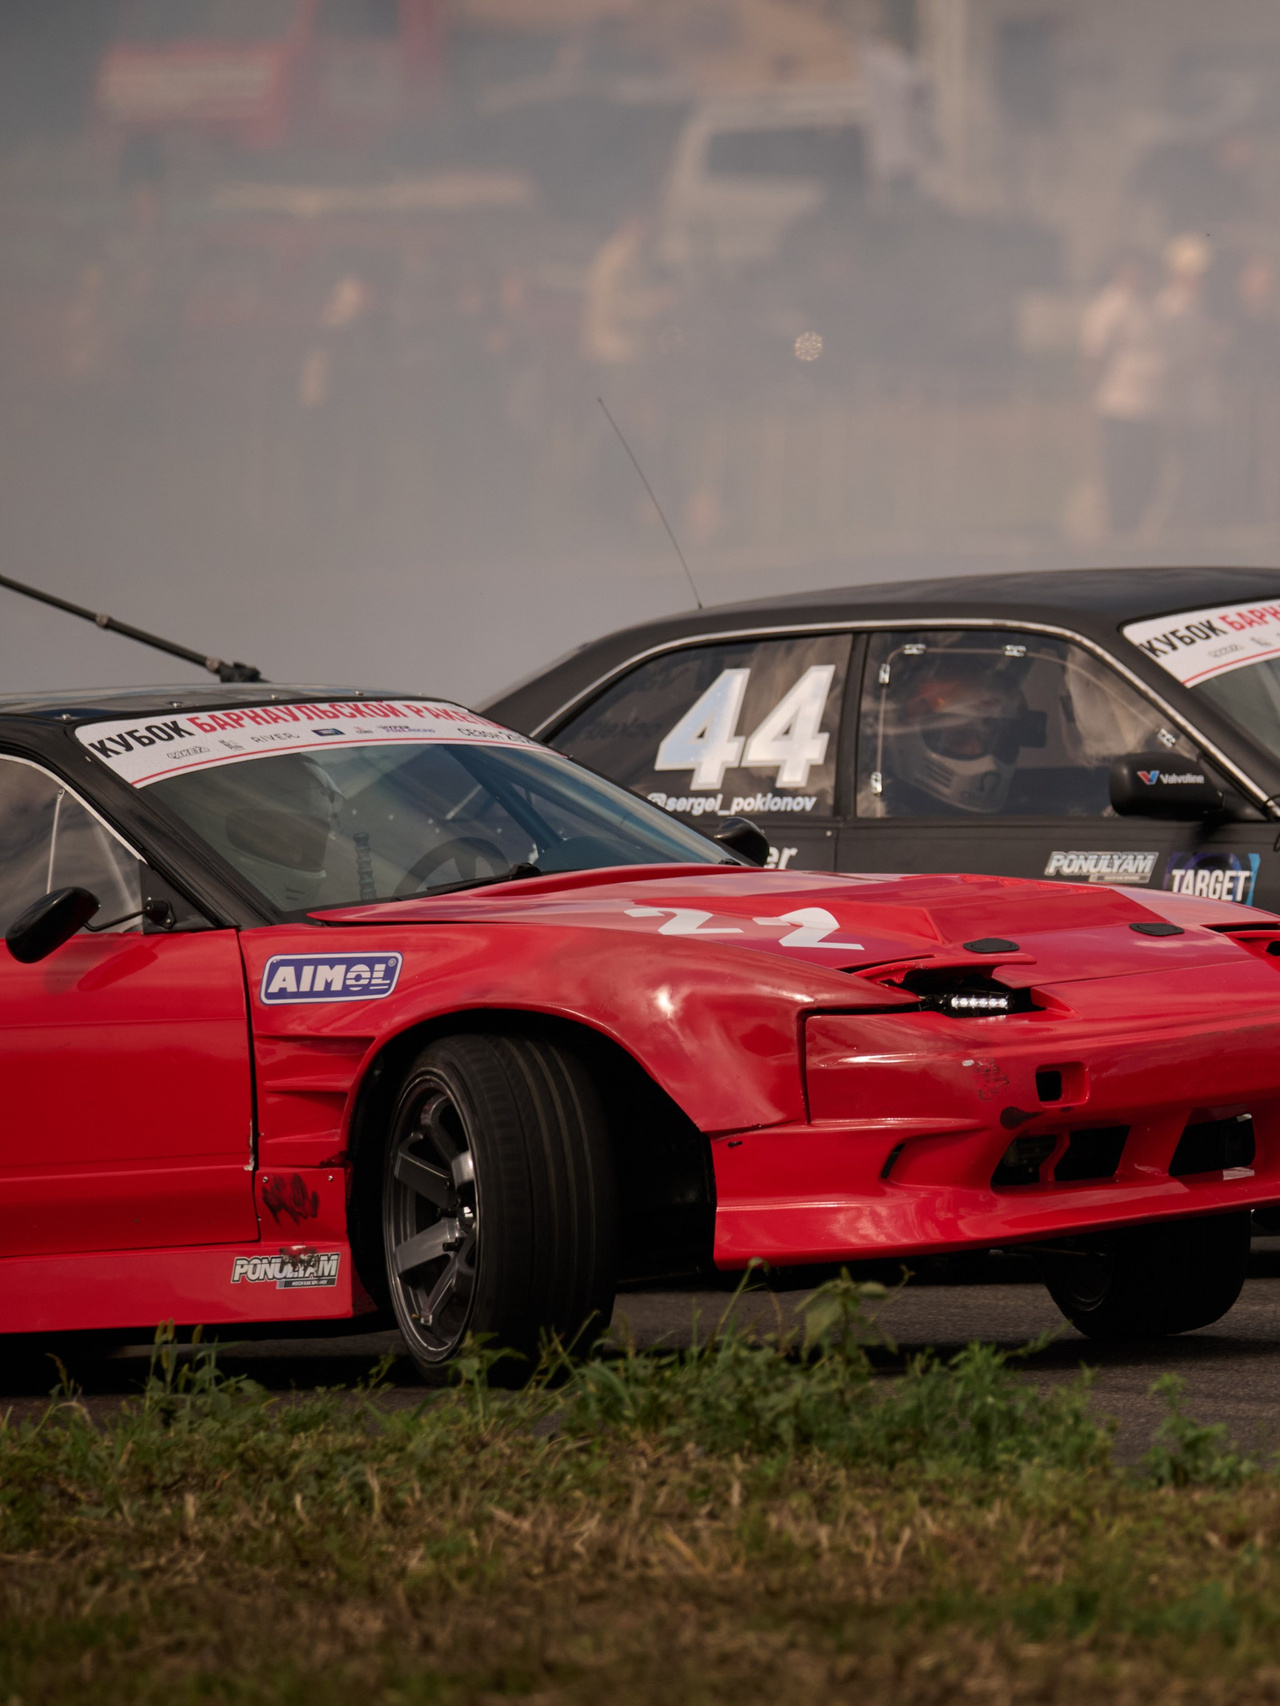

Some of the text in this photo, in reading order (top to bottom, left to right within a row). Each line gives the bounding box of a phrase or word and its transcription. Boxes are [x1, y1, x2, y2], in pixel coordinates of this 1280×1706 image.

[1140, 619, 1229, 659] КУБОК
[88, 720, 196, 759] КУБОК
[186, 700, 409, 733] БАРНАУЛЬСКОЙ
[654, 664, 836, 790] 44
[1046, 852, 1158, 875] PONULYAM
[1171, 868, 1252, 902] TARGET
[267, 963, 391, 993] AIMOL
